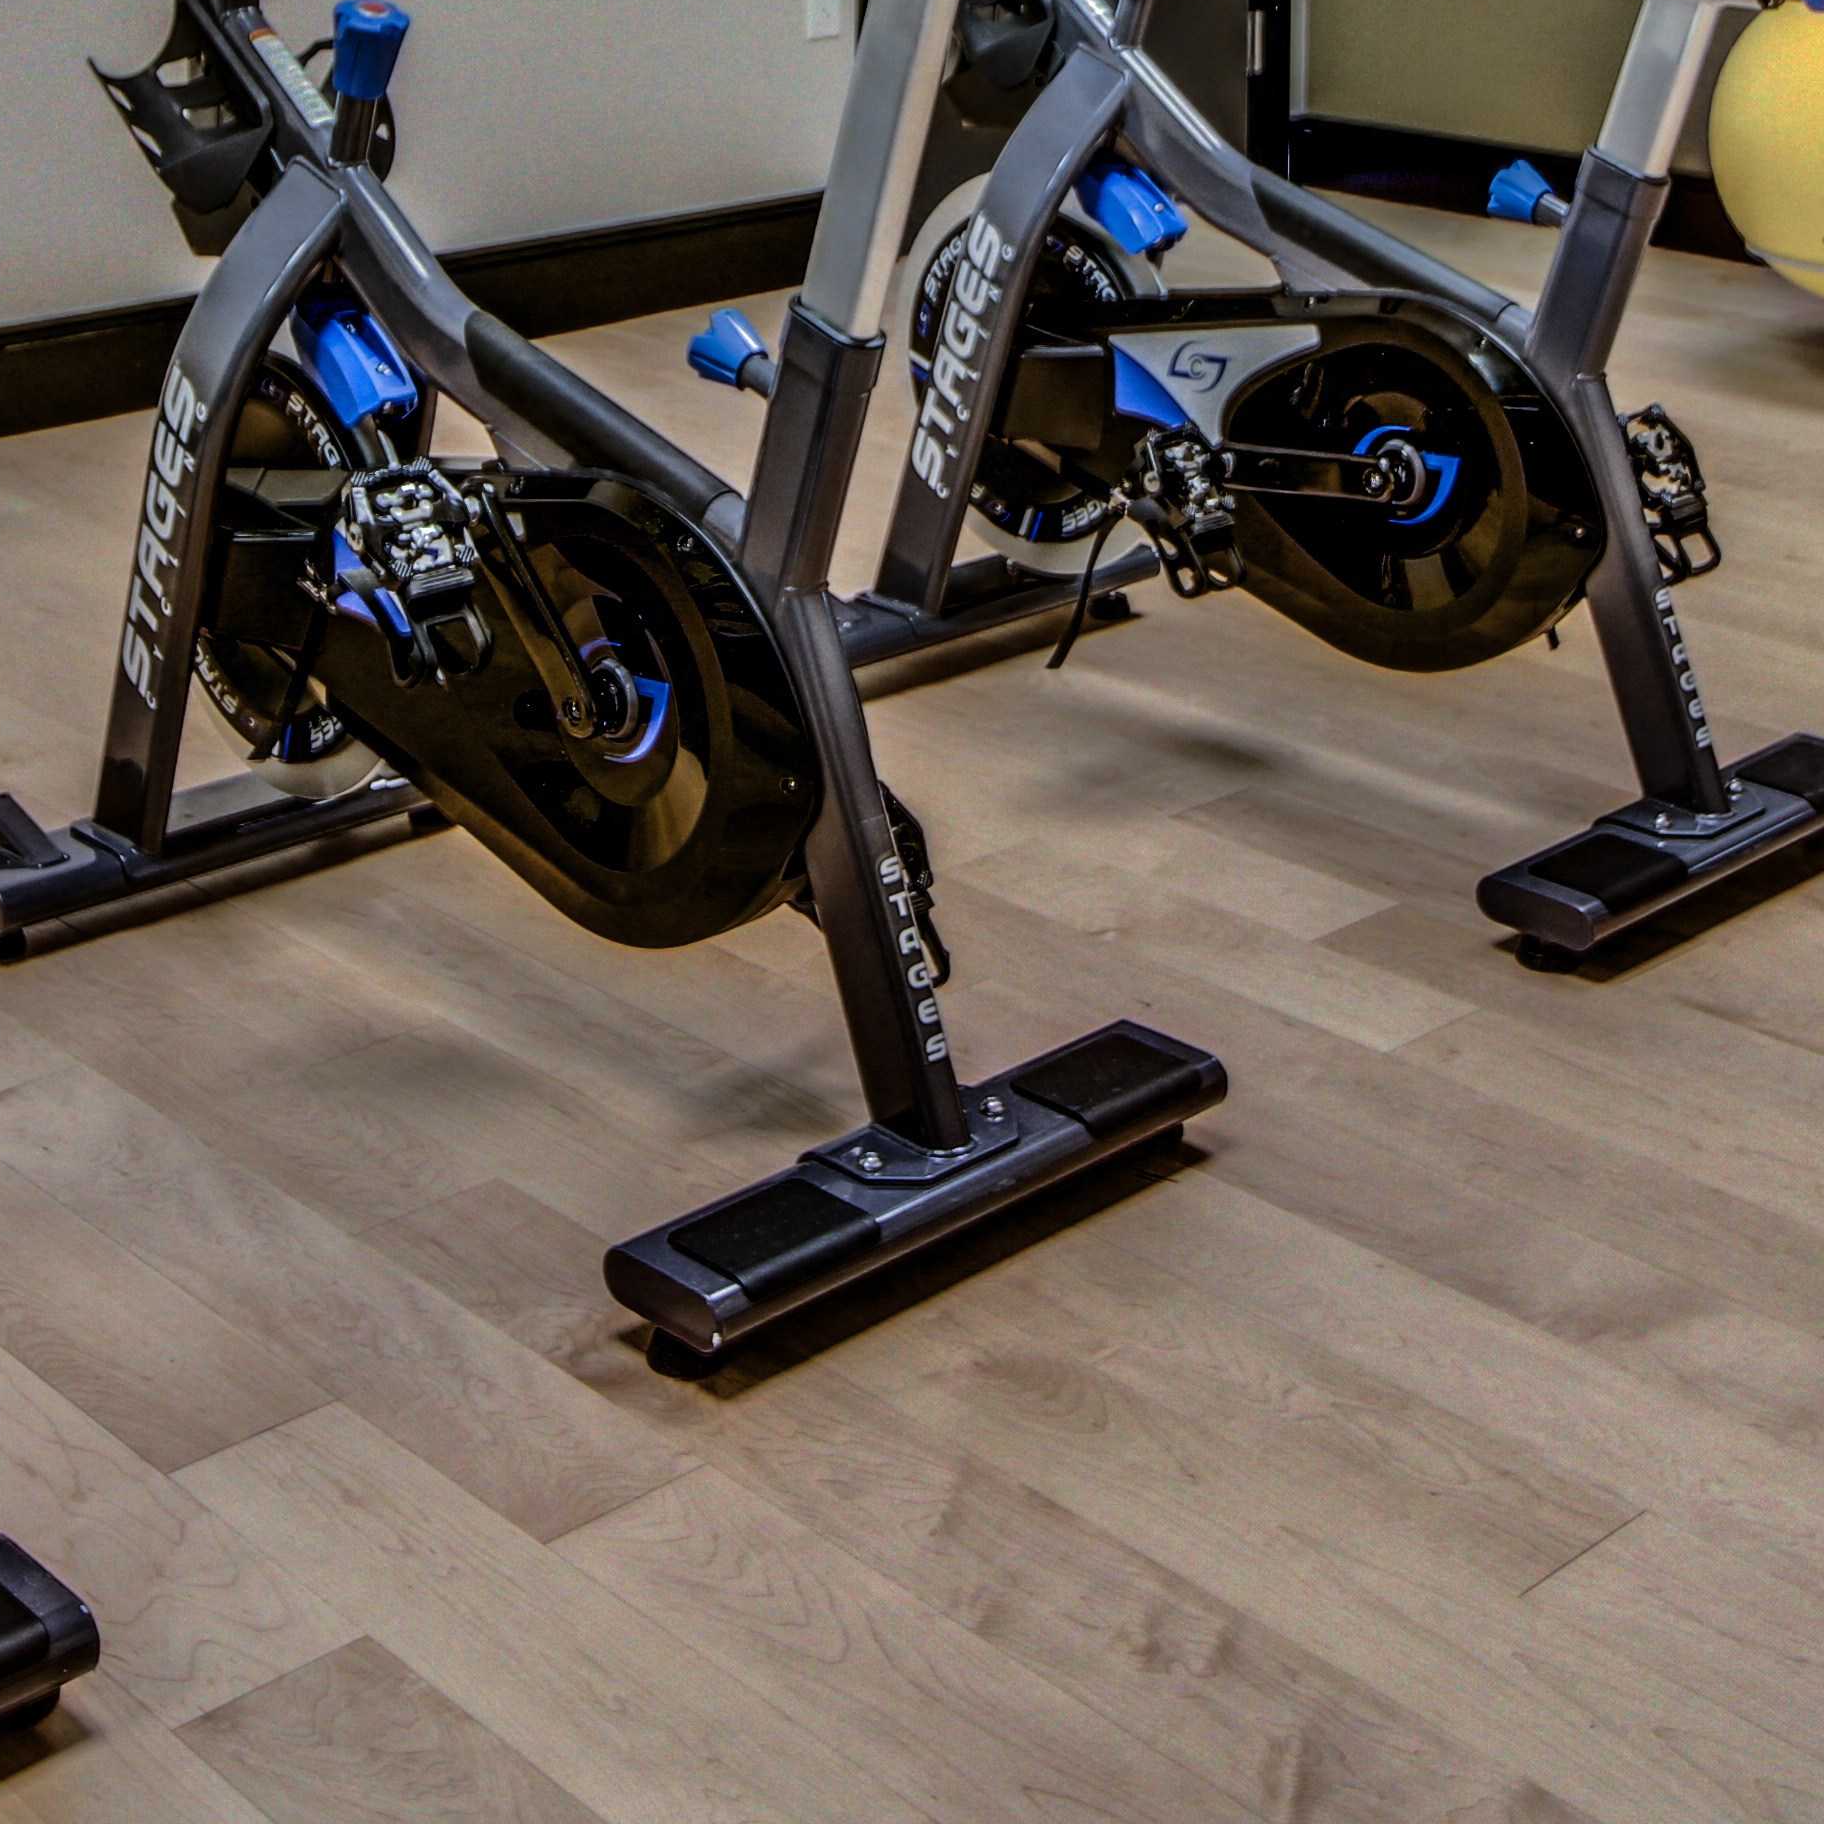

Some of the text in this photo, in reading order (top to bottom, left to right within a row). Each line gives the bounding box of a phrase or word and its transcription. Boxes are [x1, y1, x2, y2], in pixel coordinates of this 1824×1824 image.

[912, 211, 1001, 492] STAGES
[924, 230, 966, 297] STAG
[287, 392, 341, 467] STAG
[122, 365, 196, 698] STAGES
[1654, 585, 1713, 749] STAGES
[879, 855, 949, 1063] STAGES
